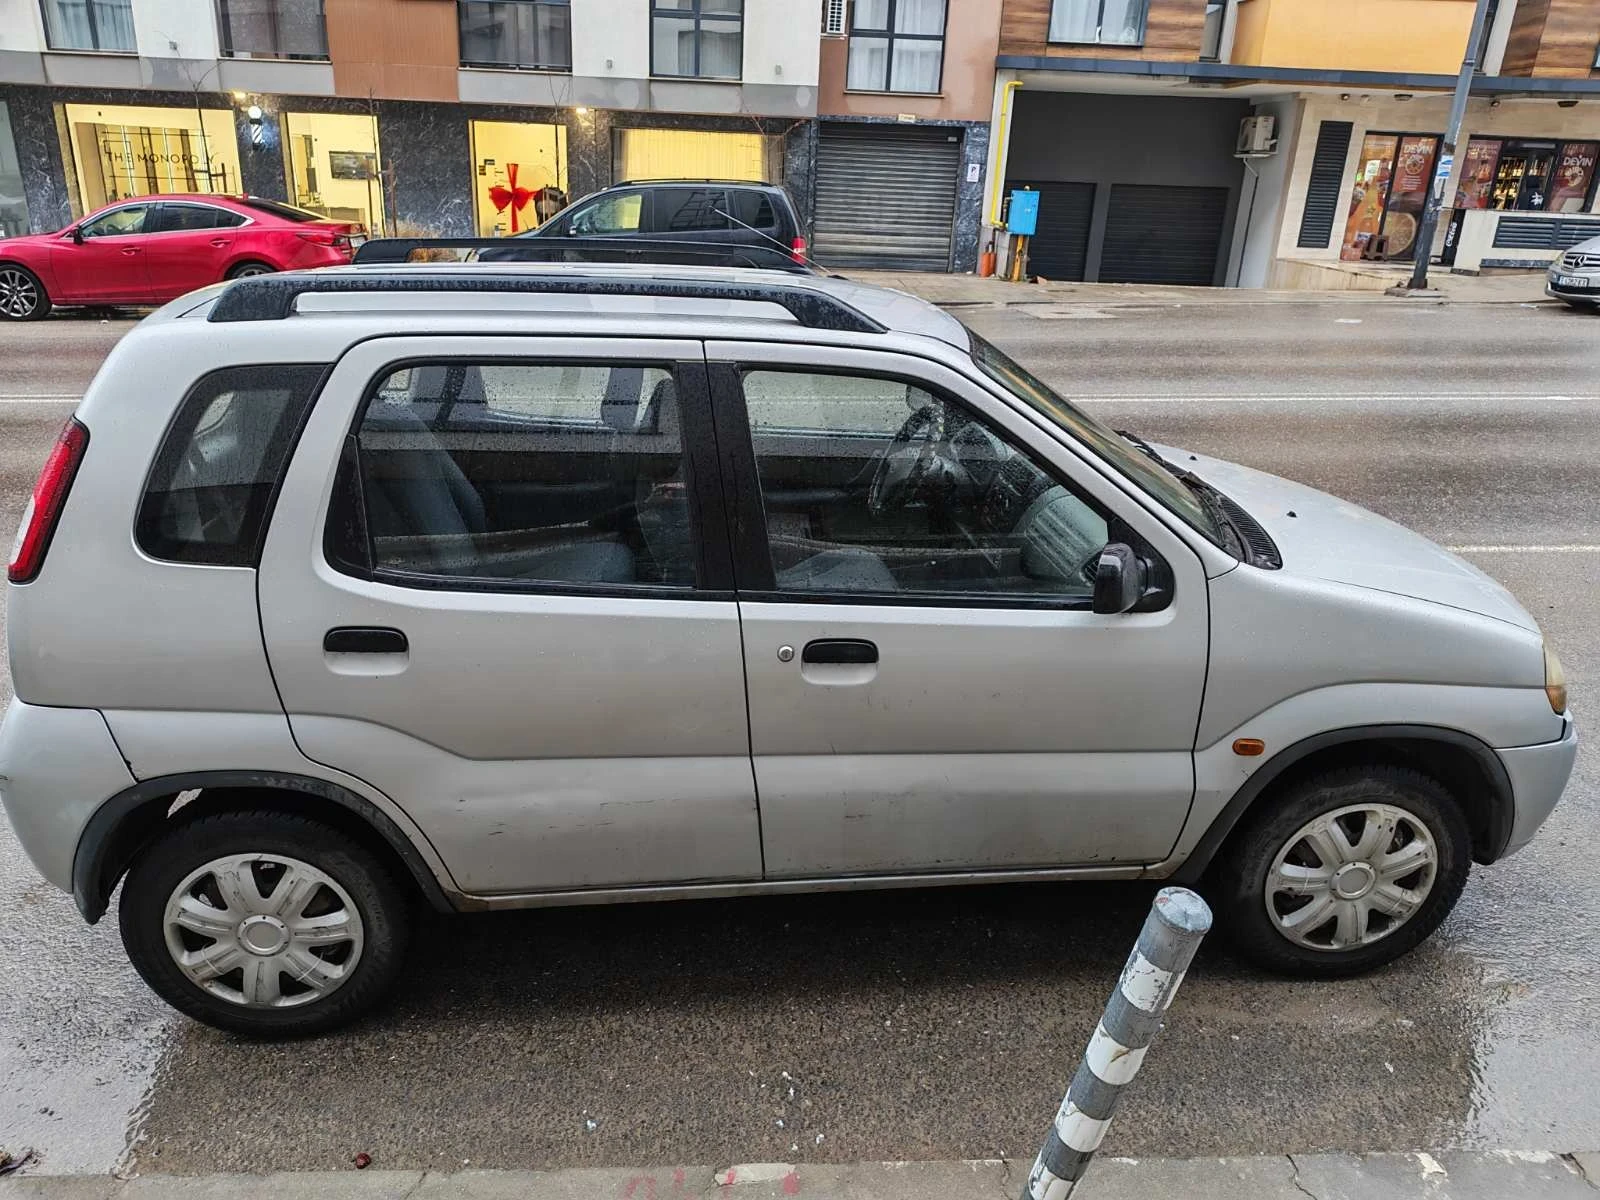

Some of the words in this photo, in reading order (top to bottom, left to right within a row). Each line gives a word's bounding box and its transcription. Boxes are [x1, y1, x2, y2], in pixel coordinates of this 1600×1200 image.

[1403, 144, 1433, 154] DEVIN
[105, 152, 132, 163] THE
[1563, 156, 1593, 167] DEVIN
